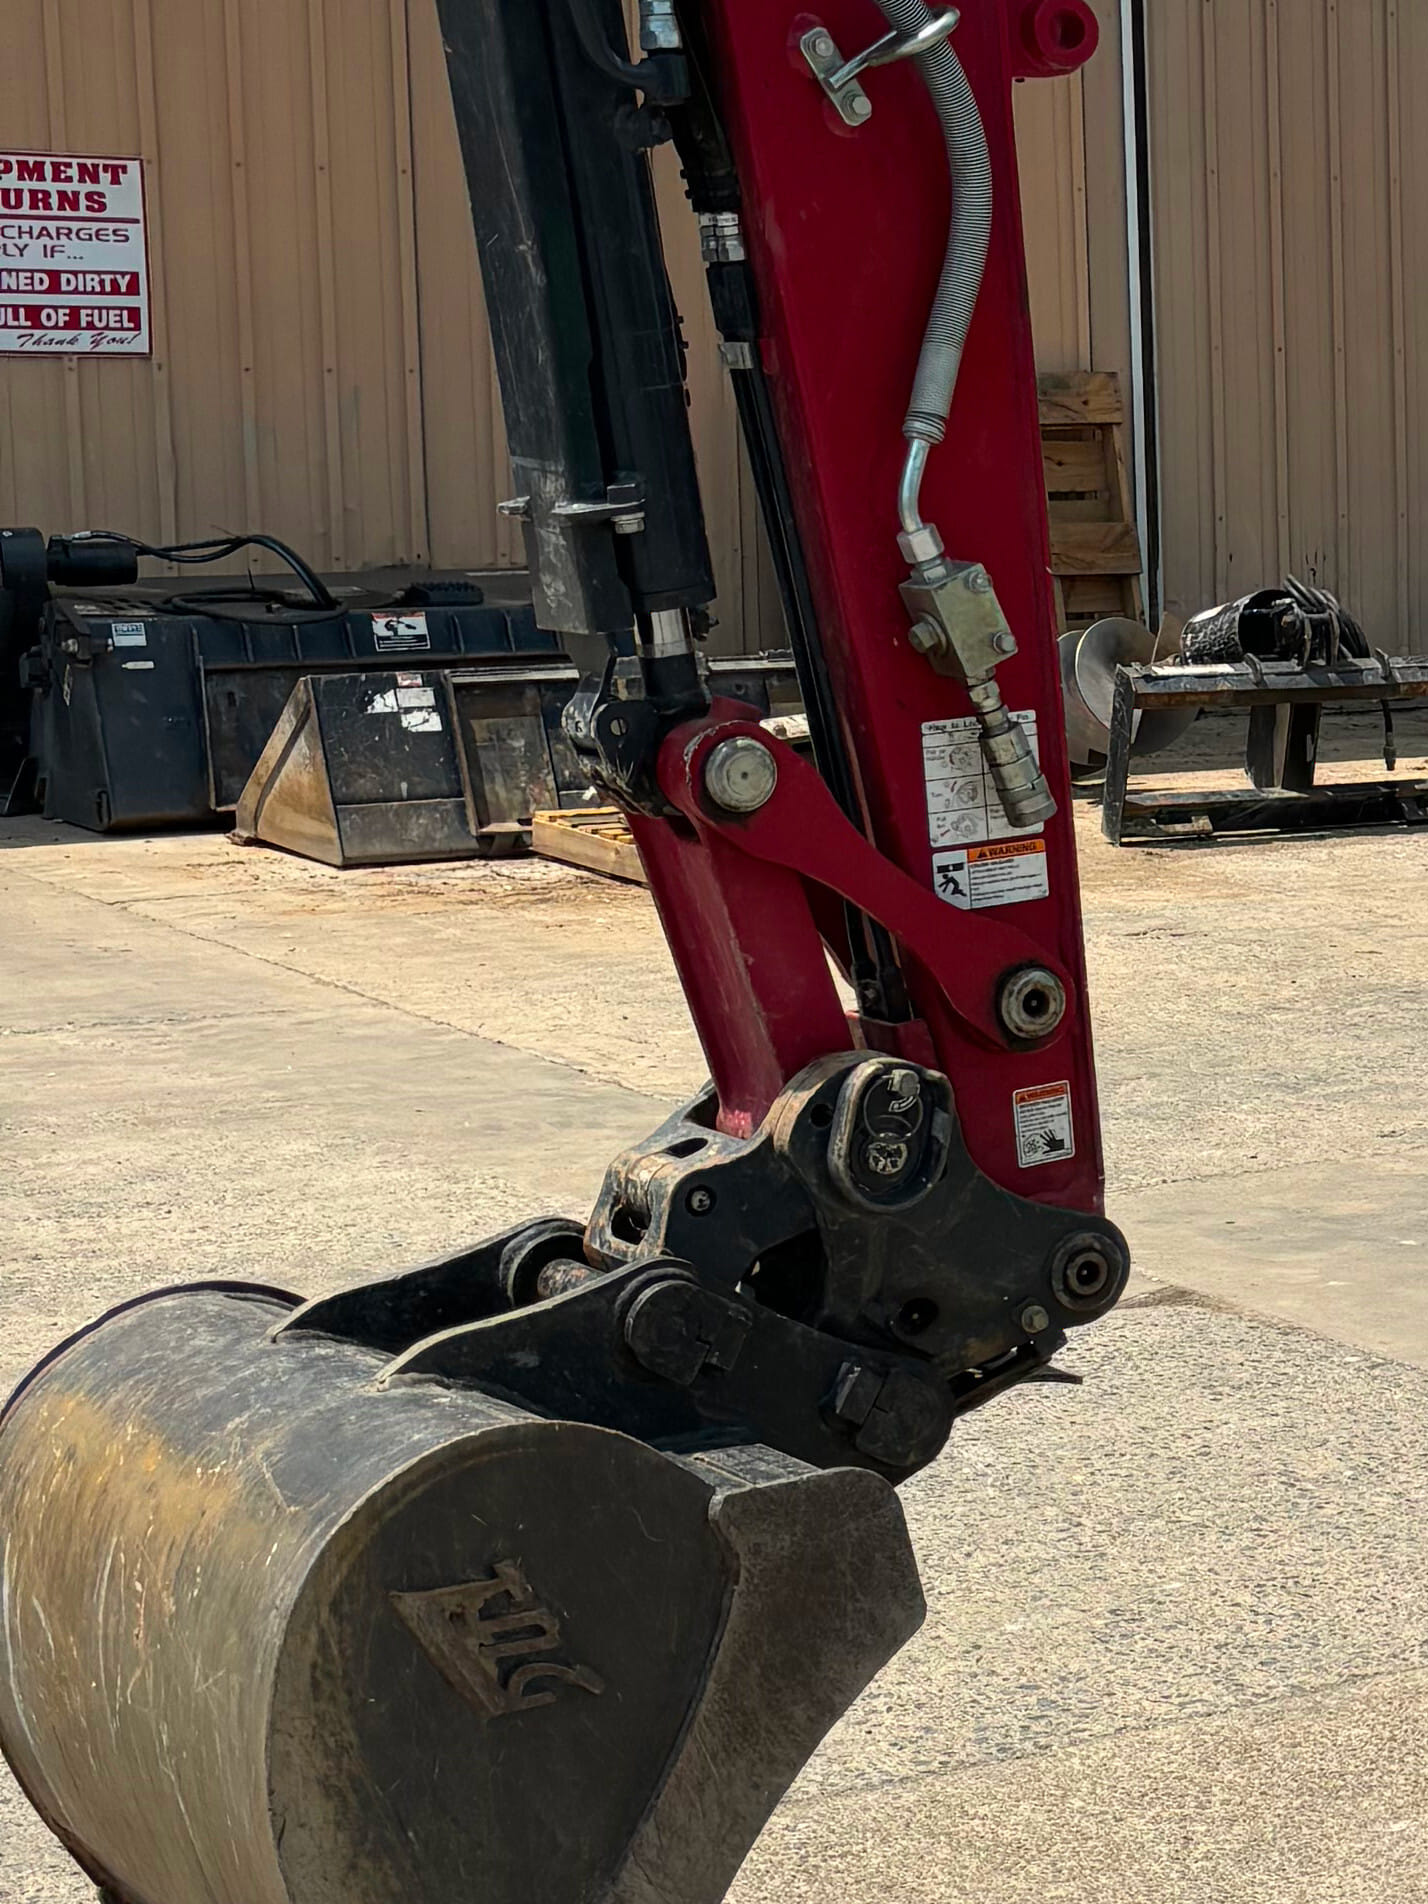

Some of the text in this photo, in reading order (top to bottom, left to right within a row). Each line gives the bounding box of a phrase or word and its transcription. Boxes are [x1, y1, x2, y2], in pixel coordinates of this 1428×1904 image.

[0, 188, 107, 213] URNS
[0, 225, 130, 243] CHARGES
[60, 273, 131, 293] DIRTY
[40, 308, 70, 327] OF
[80, 309, 134, 328] FUEL
[17, 332, 141, 351] Thank You!
